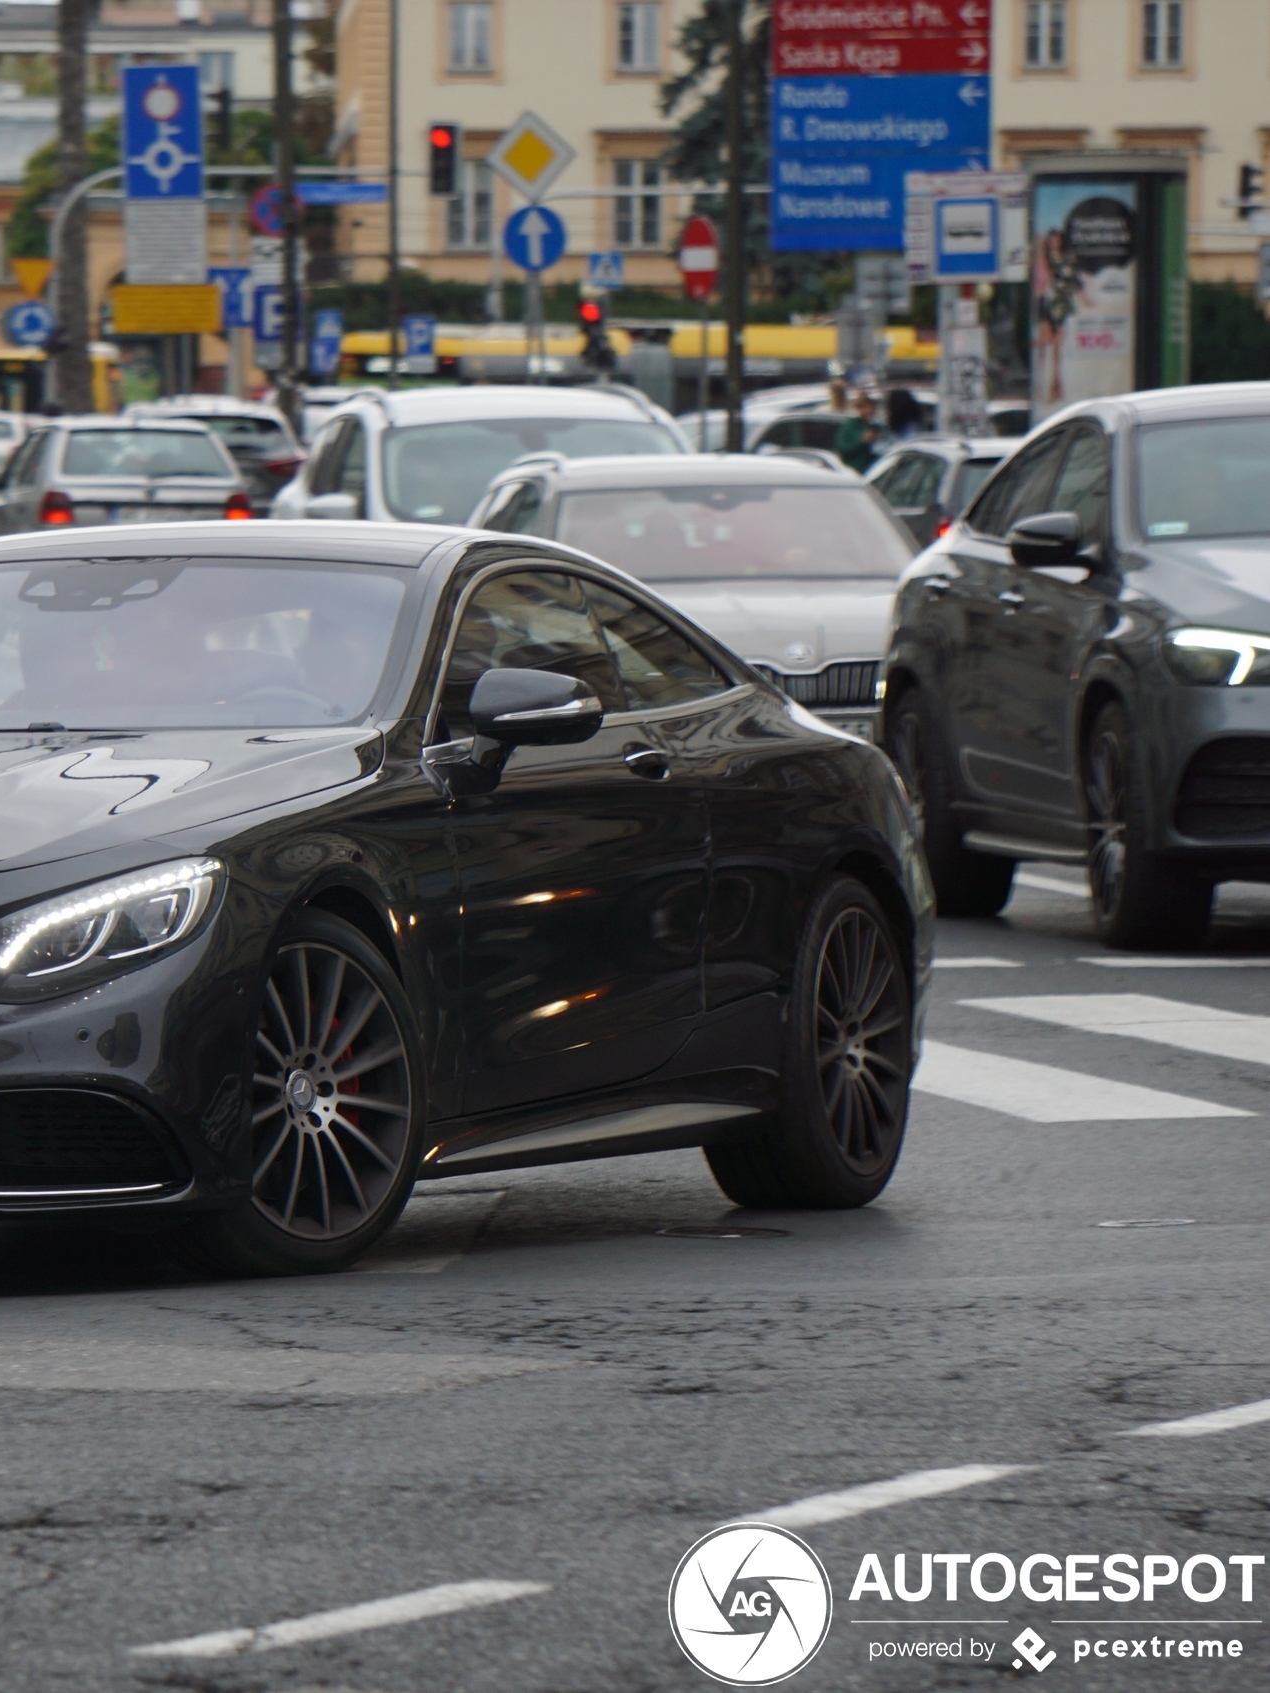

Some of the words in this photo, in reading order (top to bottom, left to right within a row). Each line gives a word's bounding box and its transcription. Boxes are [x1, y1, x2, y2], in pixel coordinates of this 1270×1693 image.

[780, 42, 841, 68] Saska
[780, 83, 849, 108] Rondo
[780, 116, 800, 140] R.
[804, 115, 948, 147] Dmowskiego
[780, 161, 870, 185] Muzeum
[780, 193, 890, 218] Narodowe
